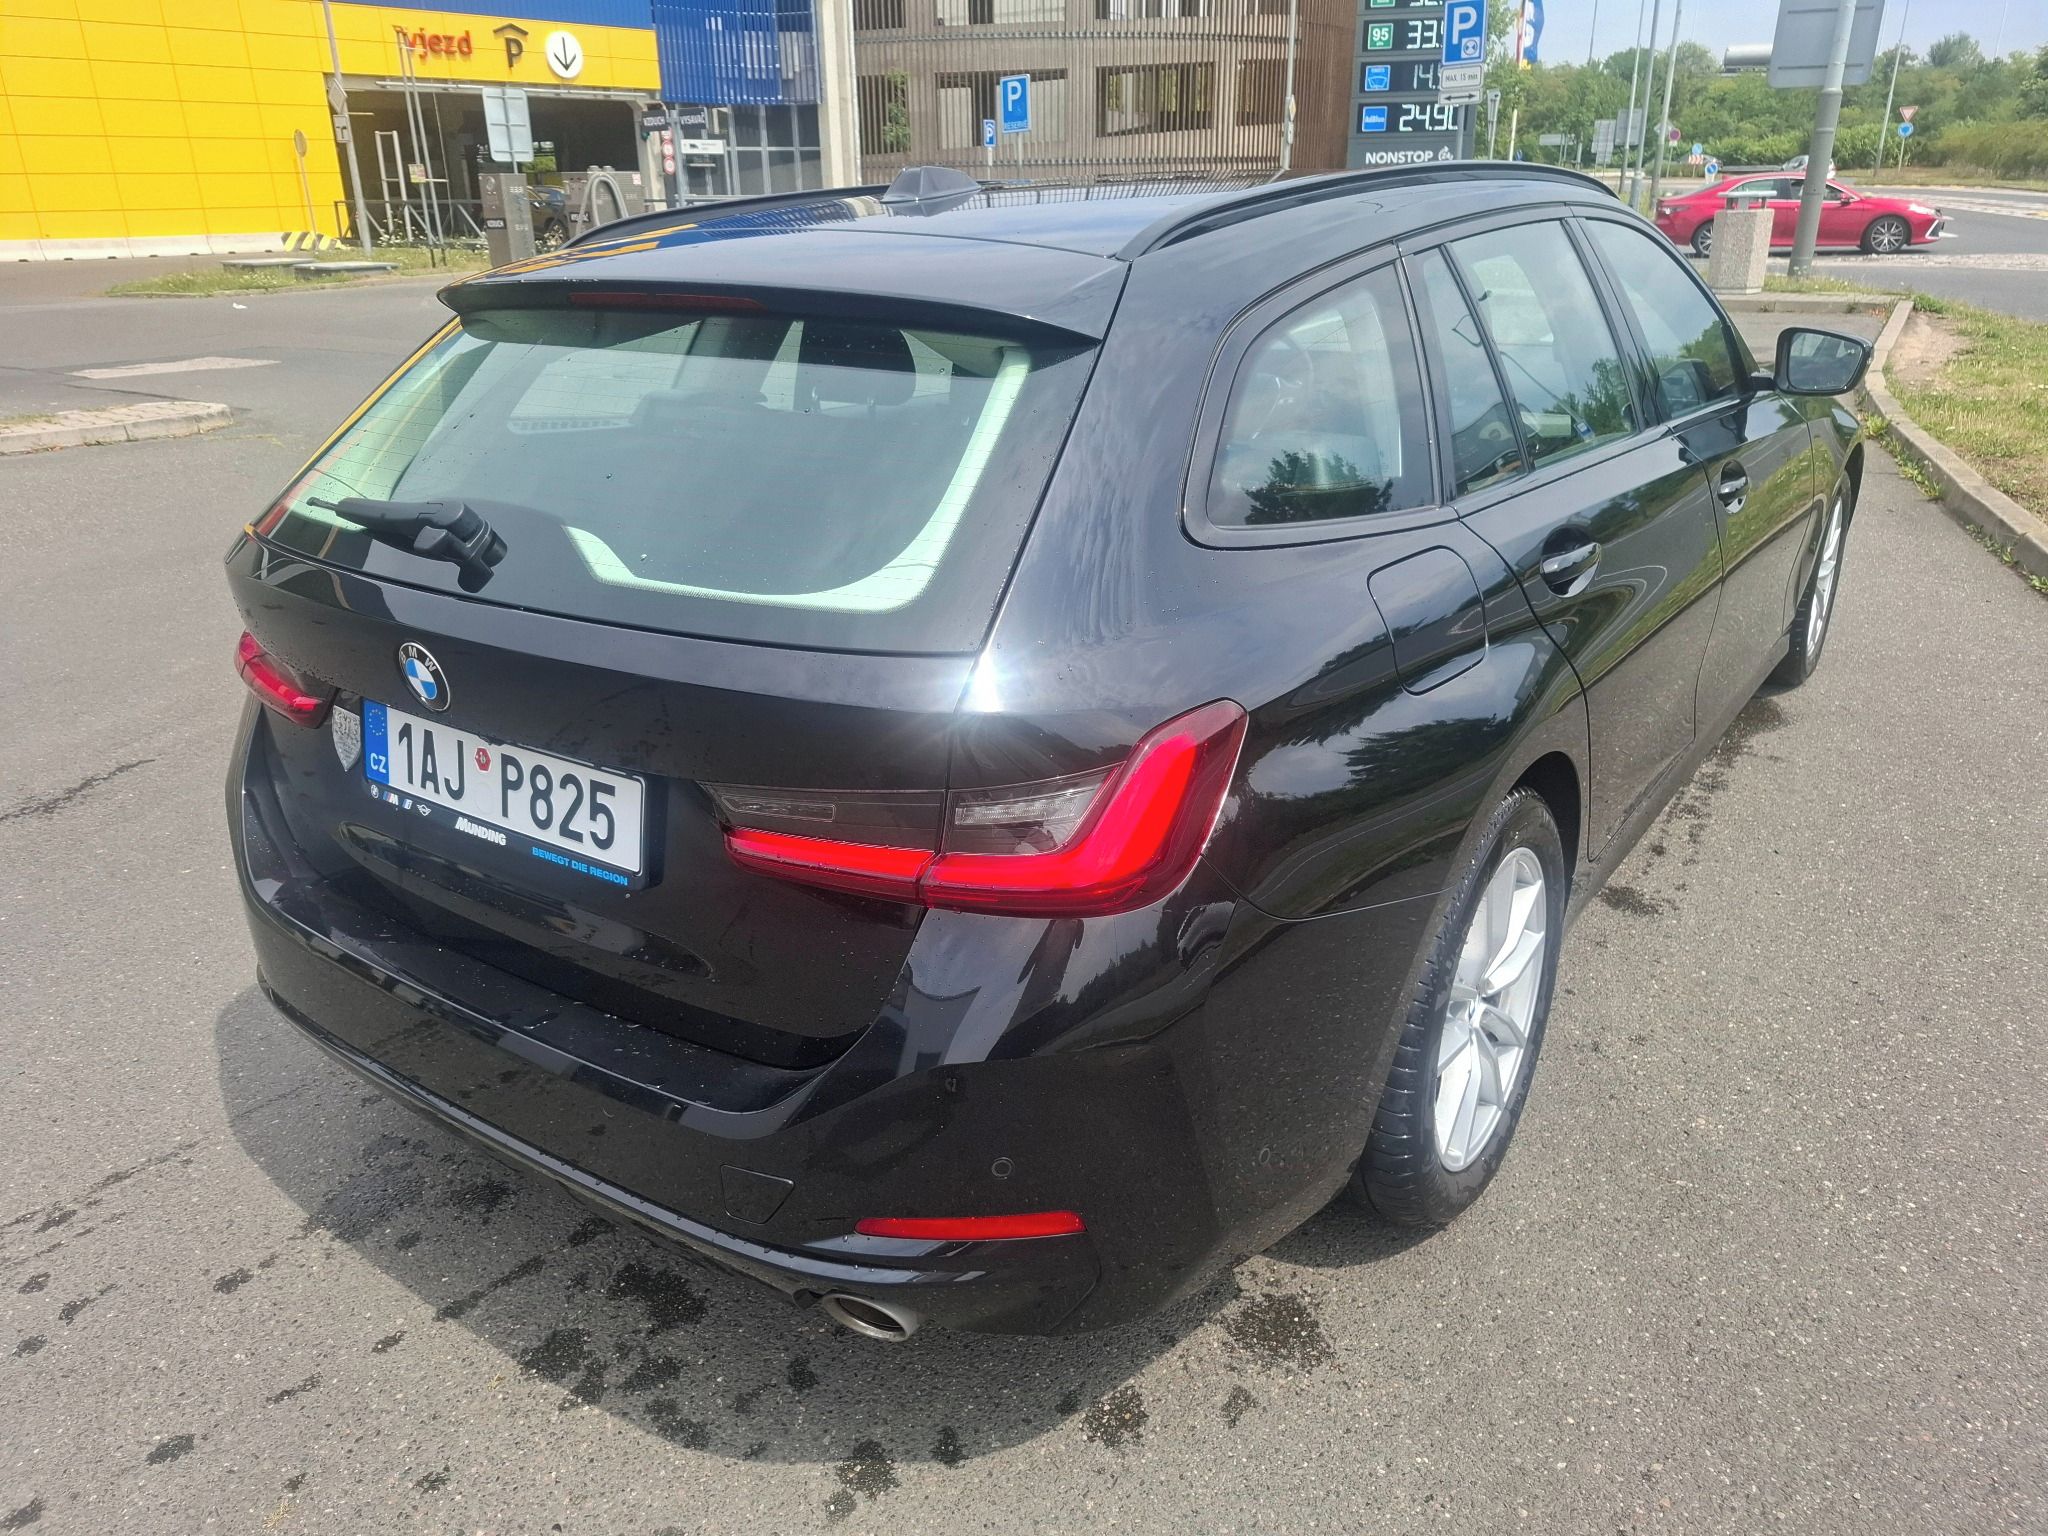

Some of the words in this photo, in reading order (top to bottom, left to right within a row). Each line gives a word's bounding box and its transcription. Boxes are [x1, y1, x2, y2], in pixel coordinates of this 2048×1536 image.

[1372, 27, 1390, 41] 95
[1413, 63, 1440, 90] 14.
[1366, 151, 1434, 165] NONSTOP
[370, 752, 387, 774] CZ
[398, 722, 465, 801] 1AJ
[500, 752, 616, 851] P825
[532, 846, 569, 867] BEWEGT
[571, 860, 588, 873] DIE
[589, 866, 628, 886] REGION
